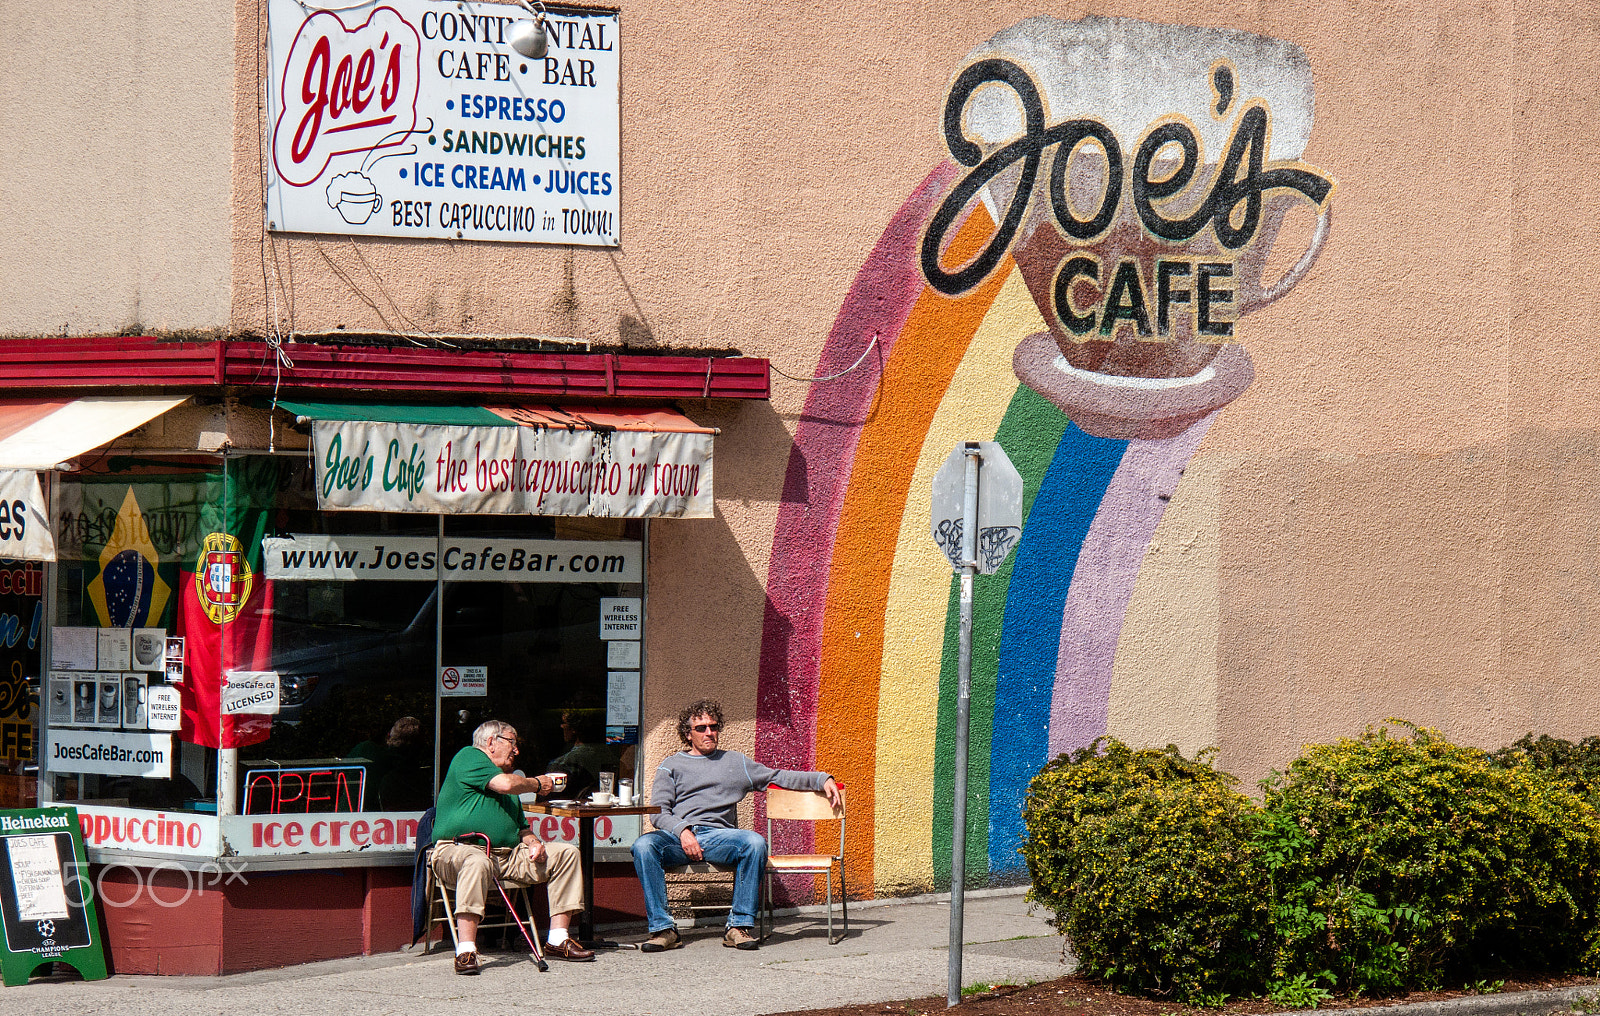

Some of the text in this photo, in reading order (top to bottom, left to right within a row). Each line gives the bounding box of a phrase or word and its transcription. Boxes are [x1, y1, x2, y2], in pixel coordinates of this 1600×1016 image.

[421, 11, 613, 52] CONTINTAL
[438, 50, 597, 87] CAFE BAR
[291, 31, 402, 164] Joe's
[461, 94, 566, 123] ESPRESSO
[442, 129, 586, 160] SANDWICHES
[414, 162, 613, 196] ICE CREAM JUICES
[921, 58, 1333, 295] Joe's
[390, 200, 613, 236] BEST CAPUCCINO in TOWN!
[1055, 256, 1234, 337] CAFE
[323, 432, 373, 499] Joe's
[382, 438, 426, 501] Café
[436, 441, 468, 493] the
[628, 449, 648, 496] in
[653, 452, 701, 498] town
[226, 690, 275, 713] LICENSED
[227, 680, 276, 690] JoesCafe.ca
[150, 704, 178, 712] WIRELESS
[53, 742, 164, 764] JoesCafeBar.com
[248, 771, 363, 815] OPEN
[0, 814, 70, 831] Heineken
[77, 814, 202, 848] ppuccino
[32, 945, 70, 954] CHAMPIONS
